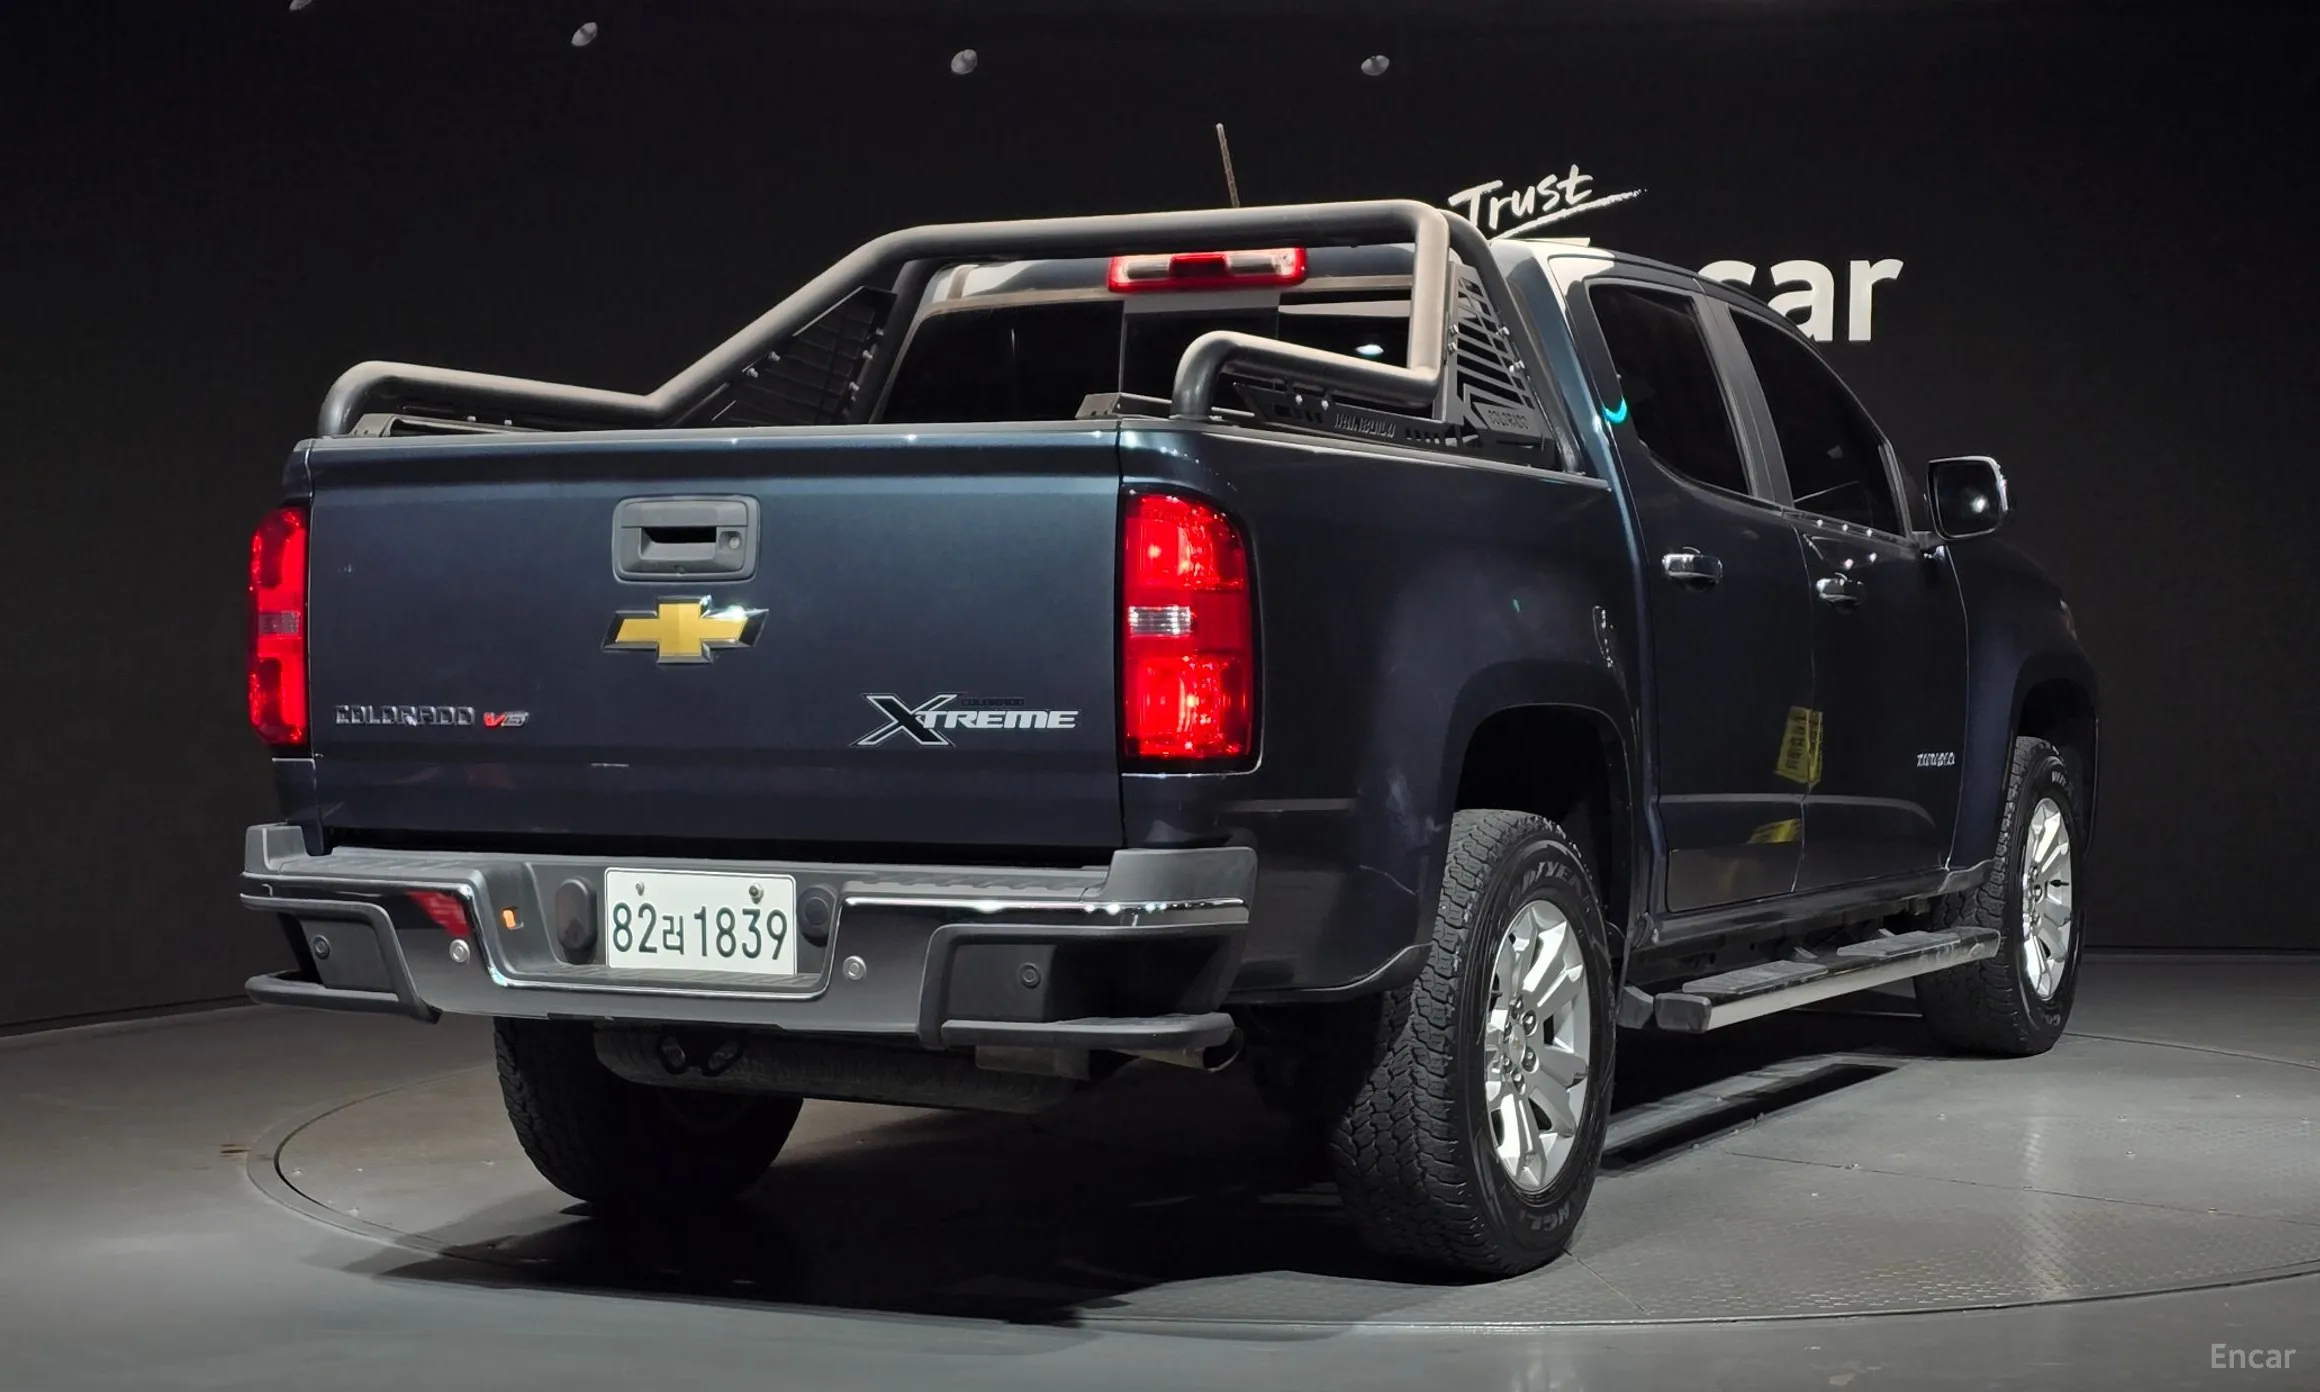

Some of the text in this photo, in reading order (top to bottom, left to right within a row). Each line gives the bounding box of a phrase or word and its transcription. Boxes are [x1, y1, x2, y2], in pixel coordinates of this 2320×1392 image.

[1448, 164, 1594, 230] Trust
[335, 704, 530, 728] COLORADO V6
[850, 691, 1080, 746] XTREME
